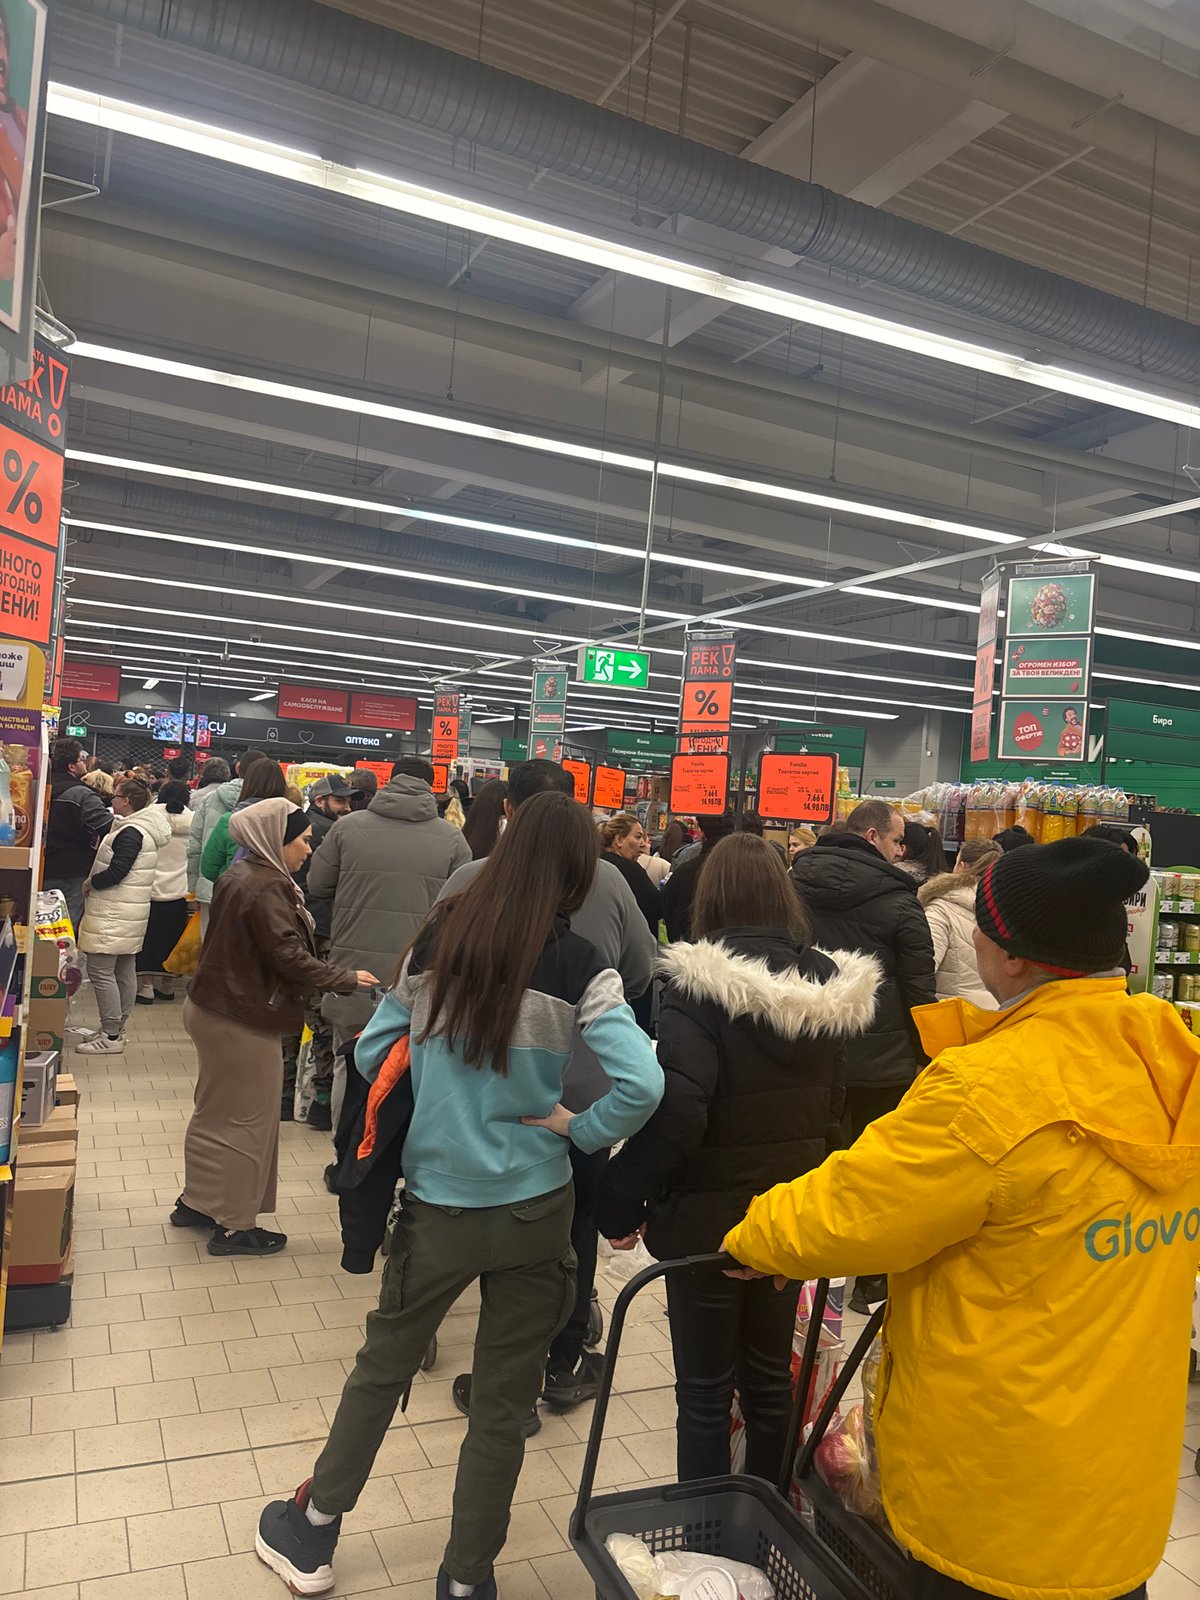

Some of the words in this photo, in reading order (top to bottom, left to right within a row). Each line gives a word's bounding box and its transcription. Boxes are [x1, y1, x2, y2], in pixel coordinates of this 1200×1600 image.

[3, 448, 42, 525] %
[691, 652, 719, 665] РЕК
[690, 666, 719, 675] ЛАМА
[1041, 669, 1081, 677] ВЕЛИКДЕН!
[437, 695, 451, 706] РЕК
[694, 689, 719, 716] %
[283, 701, 343, 713] САМООБСЛУЖВАНЕ
[1152, 714, 1173, 726] Бира
[440, 721, 452, 736] %
[1018, 723, 1037, 734] ТОП
[345, 735, 380, 747] аптека
[39, 982, 58, 992] FAIRY
[1084, 1207, 1200, 1262] Glovo
